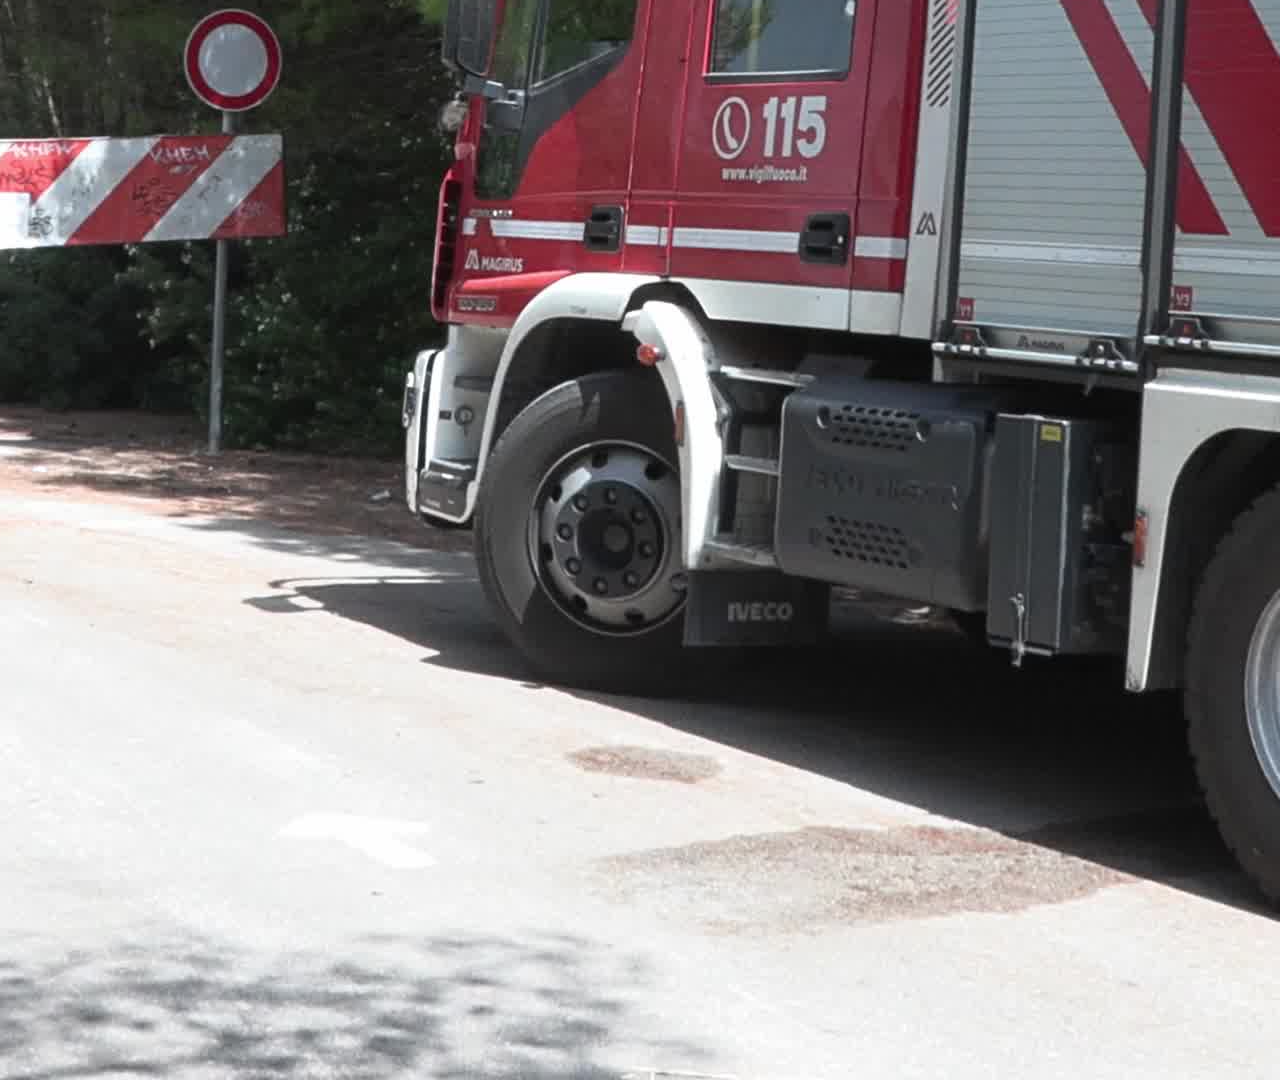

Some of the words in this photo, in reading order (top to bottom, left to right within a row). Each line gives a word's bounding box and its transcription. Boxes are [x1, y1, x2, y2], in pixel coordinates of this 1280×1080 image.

[763, 96, 827, 158] 115
[722, 165, 808, 184] www.vigilfuoco.it
[481, 256, 523, 273] MAGIRUS
[727, 601, 793, 622] IVECO
